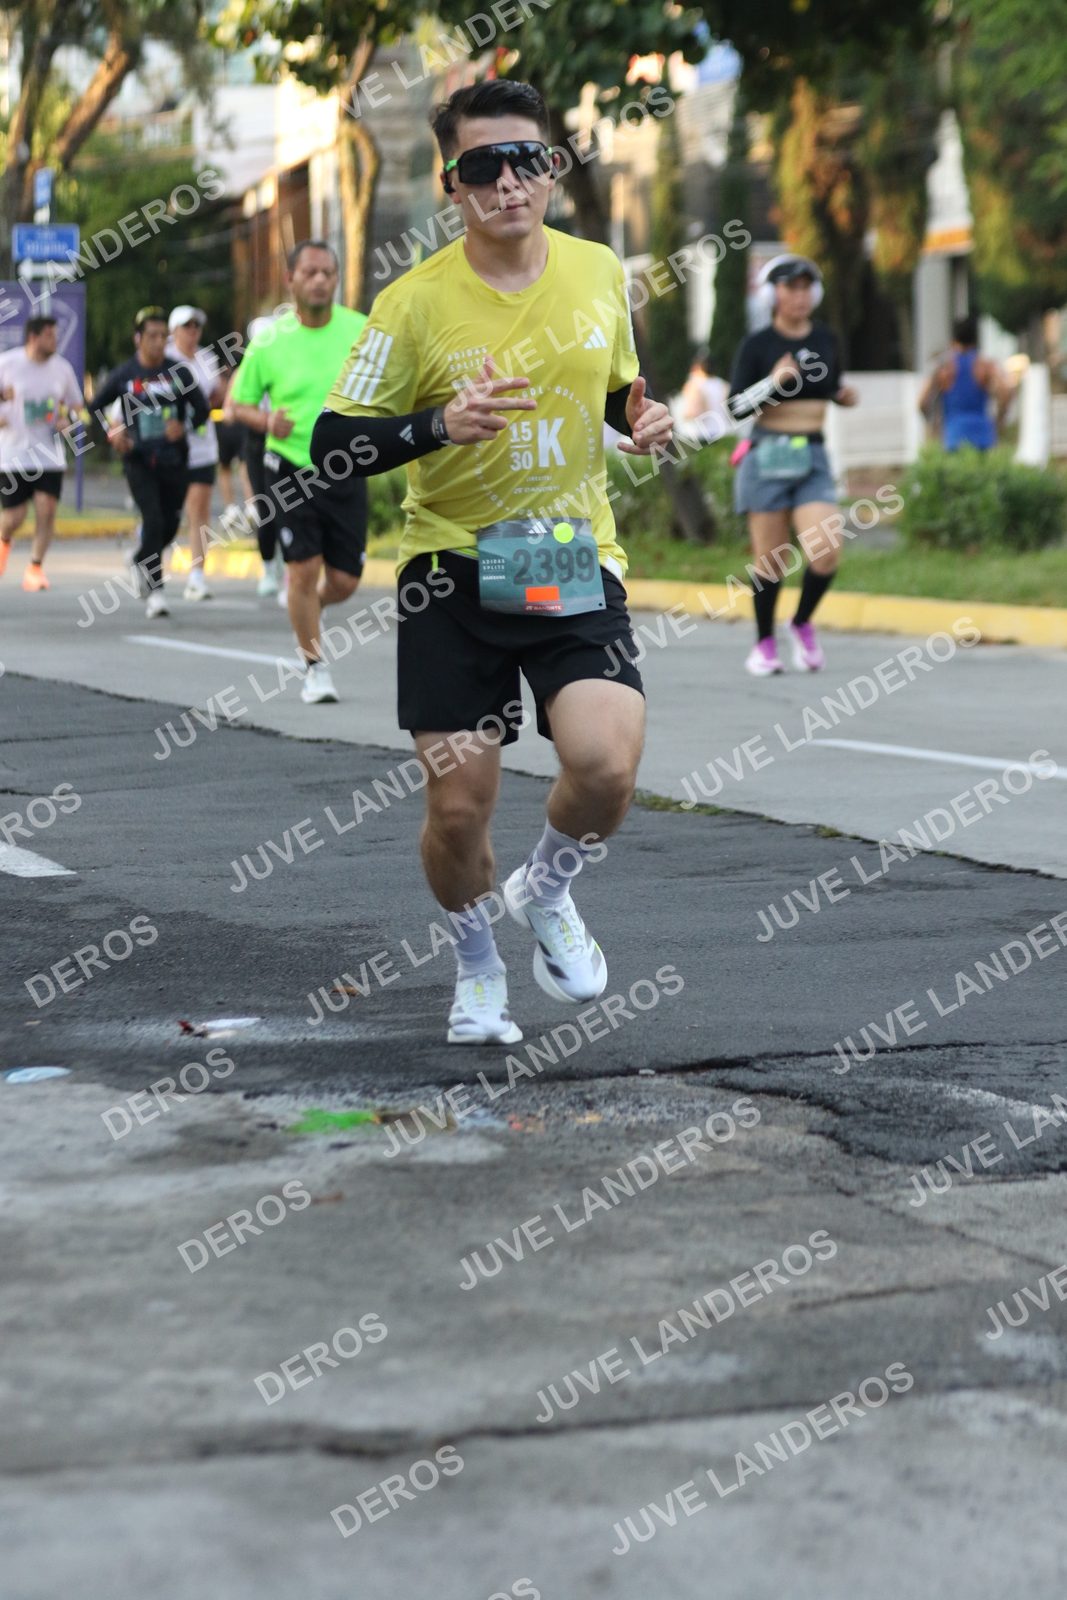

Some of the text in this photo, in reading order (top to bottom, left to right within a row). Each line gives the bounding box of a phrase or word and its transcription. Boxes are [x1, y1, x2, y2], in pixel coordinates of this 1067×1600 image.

[509, 420, 533, 443] 15
[537, 416, 567, 468] K
[509, 450, 533, 472] 30
[512, 546, 595, 585] 2399
